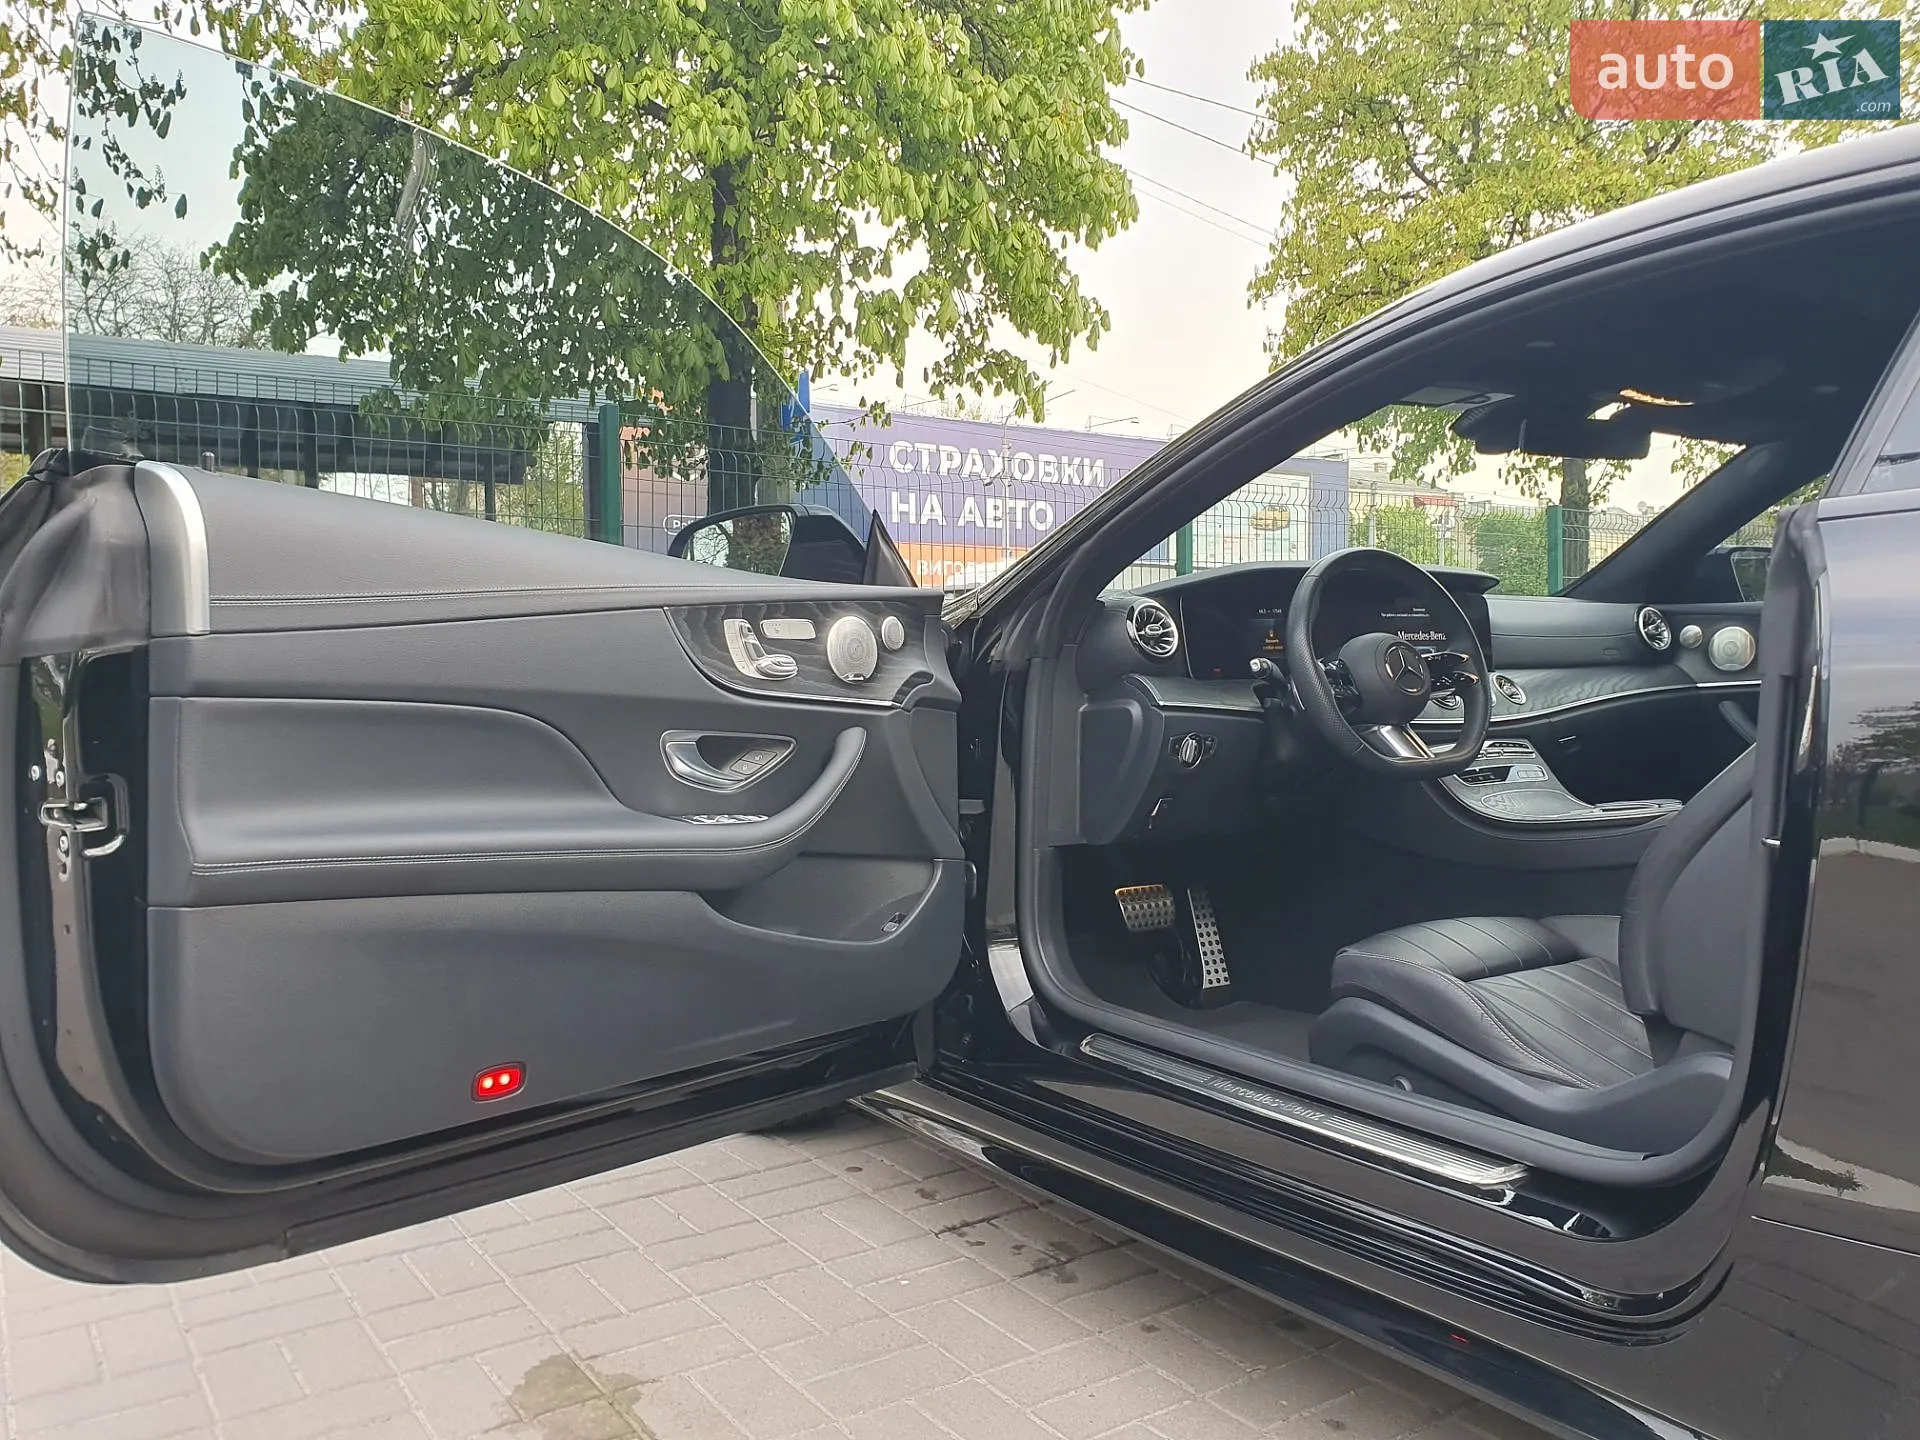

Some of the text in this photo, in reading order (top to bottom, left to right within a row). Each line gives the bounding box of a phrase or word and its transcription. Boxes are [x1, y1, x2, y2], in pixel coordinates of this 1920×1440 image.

[889, 440, 1105, 488] СТРАХОВКИ
[891, 491, 1054, 531] НА АВТО
[1397, 630, 1447, 641] Mercedes-Benz
[1208, 1077, 1326, 1121] Mercedes-Benz
